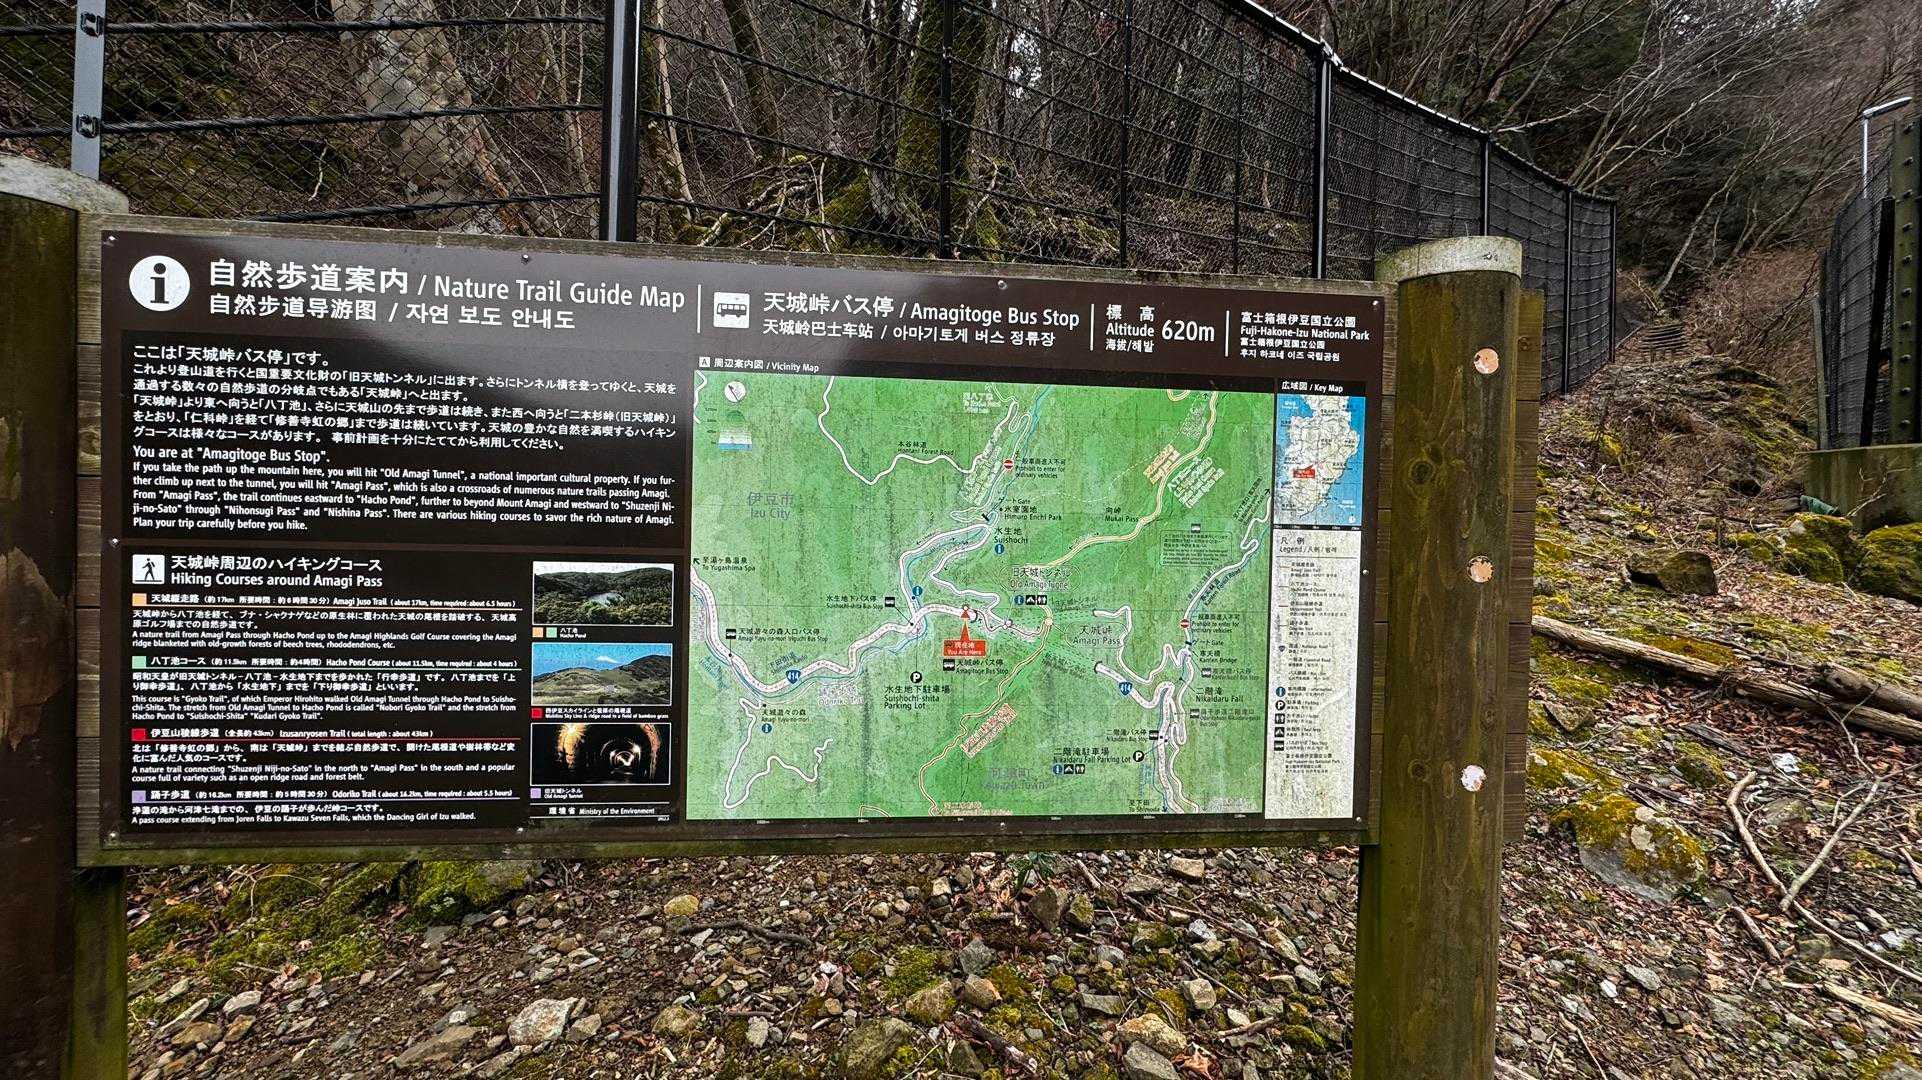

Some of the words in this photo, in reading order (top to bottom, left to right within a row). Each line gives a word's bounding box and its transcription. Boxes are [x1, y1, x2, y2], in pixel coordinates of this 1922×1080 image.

[210, 258, 408, 295] 自然歩道案内
[417, 274, 427, 296] /
[434, 275, 509, 301] Nature
[516, 279, 562, 303] Trail
[569, 282, 633, 309] Guide
[640, 285, 685, 313] Map
[210, 292, 376, 321] 自然歩道导游图
[388, 302, 398, 322] /
[405, 302, 448, 324] 자연
[458, 305, 502, 325] 보도
[511, 306, 575, 329] 안내도
[763, 291, 894, 317] 天城峠バス停
[899, 301, 906, 318] /
[910, 302, 1001, 326] Amagitoge
[1008, 307, 1037, 324] Bus
[1042, 308, 1079, 330] Stop
[1240, 311, 1355, 327] 富士箱根伊豆国立公園
[762, 318, 873, 338] 天城岭巴士车站
[880, 324, 887, 339] /
[893, 324, 967, 343] 아마기토게
[975, 325, 1004, 344] 버스
[1010, 330, 1055, 346] 정류장
[1105, 322, 1154, 336] Altitude
[1161, 319, 1214, 341] 620m
[1241, 325, 1309, 338] Fuji-Hakone-Izu
[1312, 328, 1348, 340] National
[1351, 330, 1370, 341] Park
[1105, 337, 1154, 352] 海拔/해발
[133, 345, 328, 366] ここは「天城峠バス停」です。
[772, 361, 801, 373] Vicinity
[803, 364, 819, 373] Map
[132, 445, 154, 457] You
[158, 448, 177, 458] are
[180, 447, 193, 458] at
[197, 446, 266, 463] "Amagitoge
[269, 448, 290, 461] Bus
[294, 449, 329, 464] Stop".
[133, 462, 140, 470] If
[142, 463, 159, 473] you
[162, 462, 181, 472] take
[184, 463, 199, 472] the
[202, 464, 222, 474] path
[225, 465, 237, 475] up
[240, 464, 254, 473] the
[257, 465, 299, 474] mountain
[302, 466, 324, 477] here,
[327, 468, 343, 477] you
[346, 467, 362, 476] will
[364, 467, 377, 477] hit
[380, 468, 399, 477] "Old
[402, 468, 429, 480] Amagi
[432, 469, 467, 480] Tunnel",
[478, 470, 513, 480] national
[515, 471, 557, 483] important
[559, 472, 591, 482] cultural
[593, 475, 630, 485] property.
[633, 474, 640, 483] If
[642, 477, 657, 486] you
[659, 475, 674, 484] fur-
[751, 509, 766, 519] Izu
[771, 509, 791, 521] City
[133, 516, 153, 526] Plan
[155, 519, 176, 528] your
[177, 517, 194, 529] trip
[196, 518, 235, 530] carefully
[237, 518, 265, 528] before
[267, 521, 283, 531] you
[286, 520, 307, 529] hike.
[170, 554, 382, 571] 天城峠周辺のハイキングコース
[171, 572, 211, 587] Hiking
[215, 572, 263, 585] Courses
[266, 573, 310, 585] around
[313, 574, 352, 589] Amagi
[356, 575, 382, 586] Pass
[132, 640, 151, 648] ridge
[207, 640, 246, 648] old-growth
[326, 640, 380, 649] rhododendrons,
[382, 640, 395, 648] etc.
[884, 702, 912, 711] Parking
[579, 808, 602, 816] Ministry
